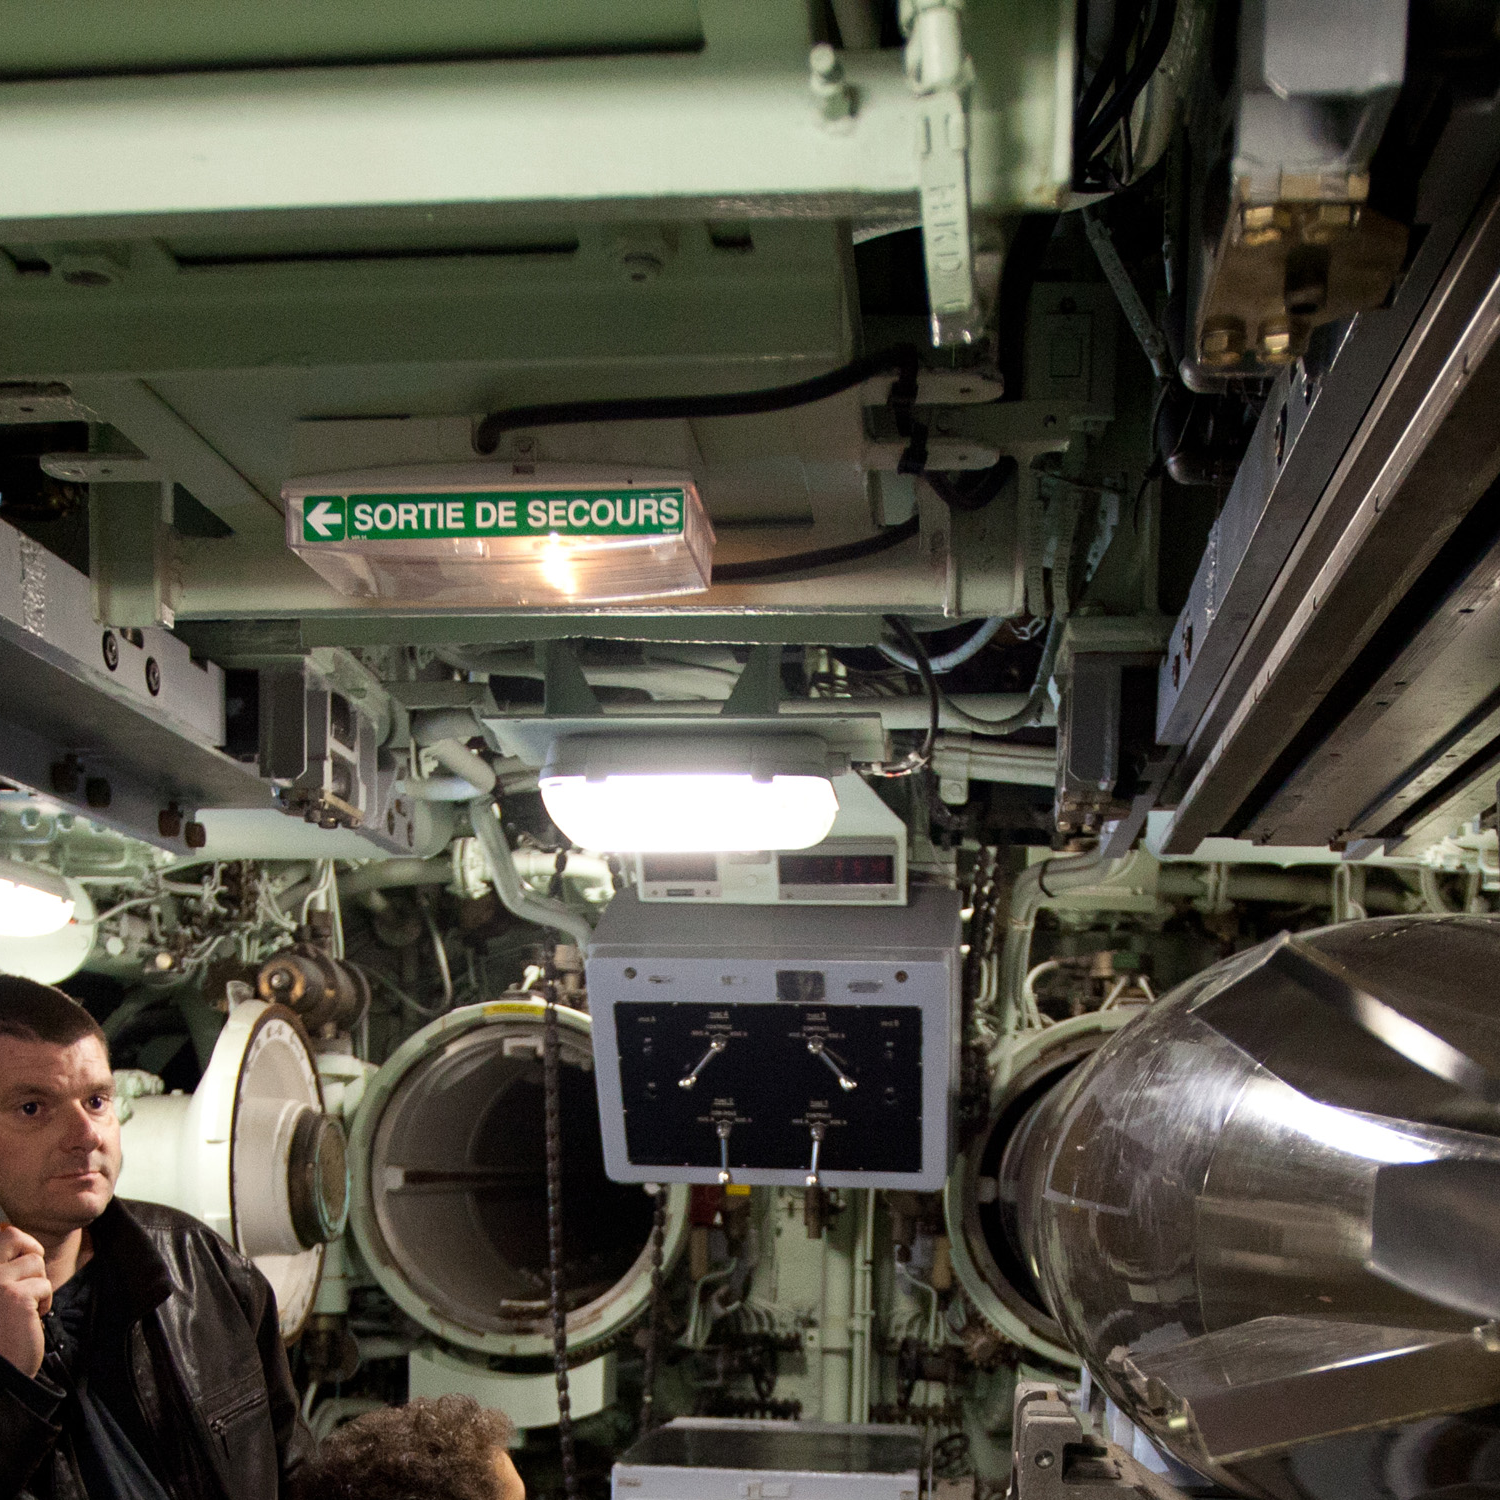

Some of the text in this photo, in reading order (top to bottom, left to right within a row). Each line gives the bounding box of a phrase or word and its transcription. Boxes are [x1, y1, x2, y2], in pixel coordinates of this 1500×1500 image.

[353, 497, 680, 532] SORTIE DE SECOURS
